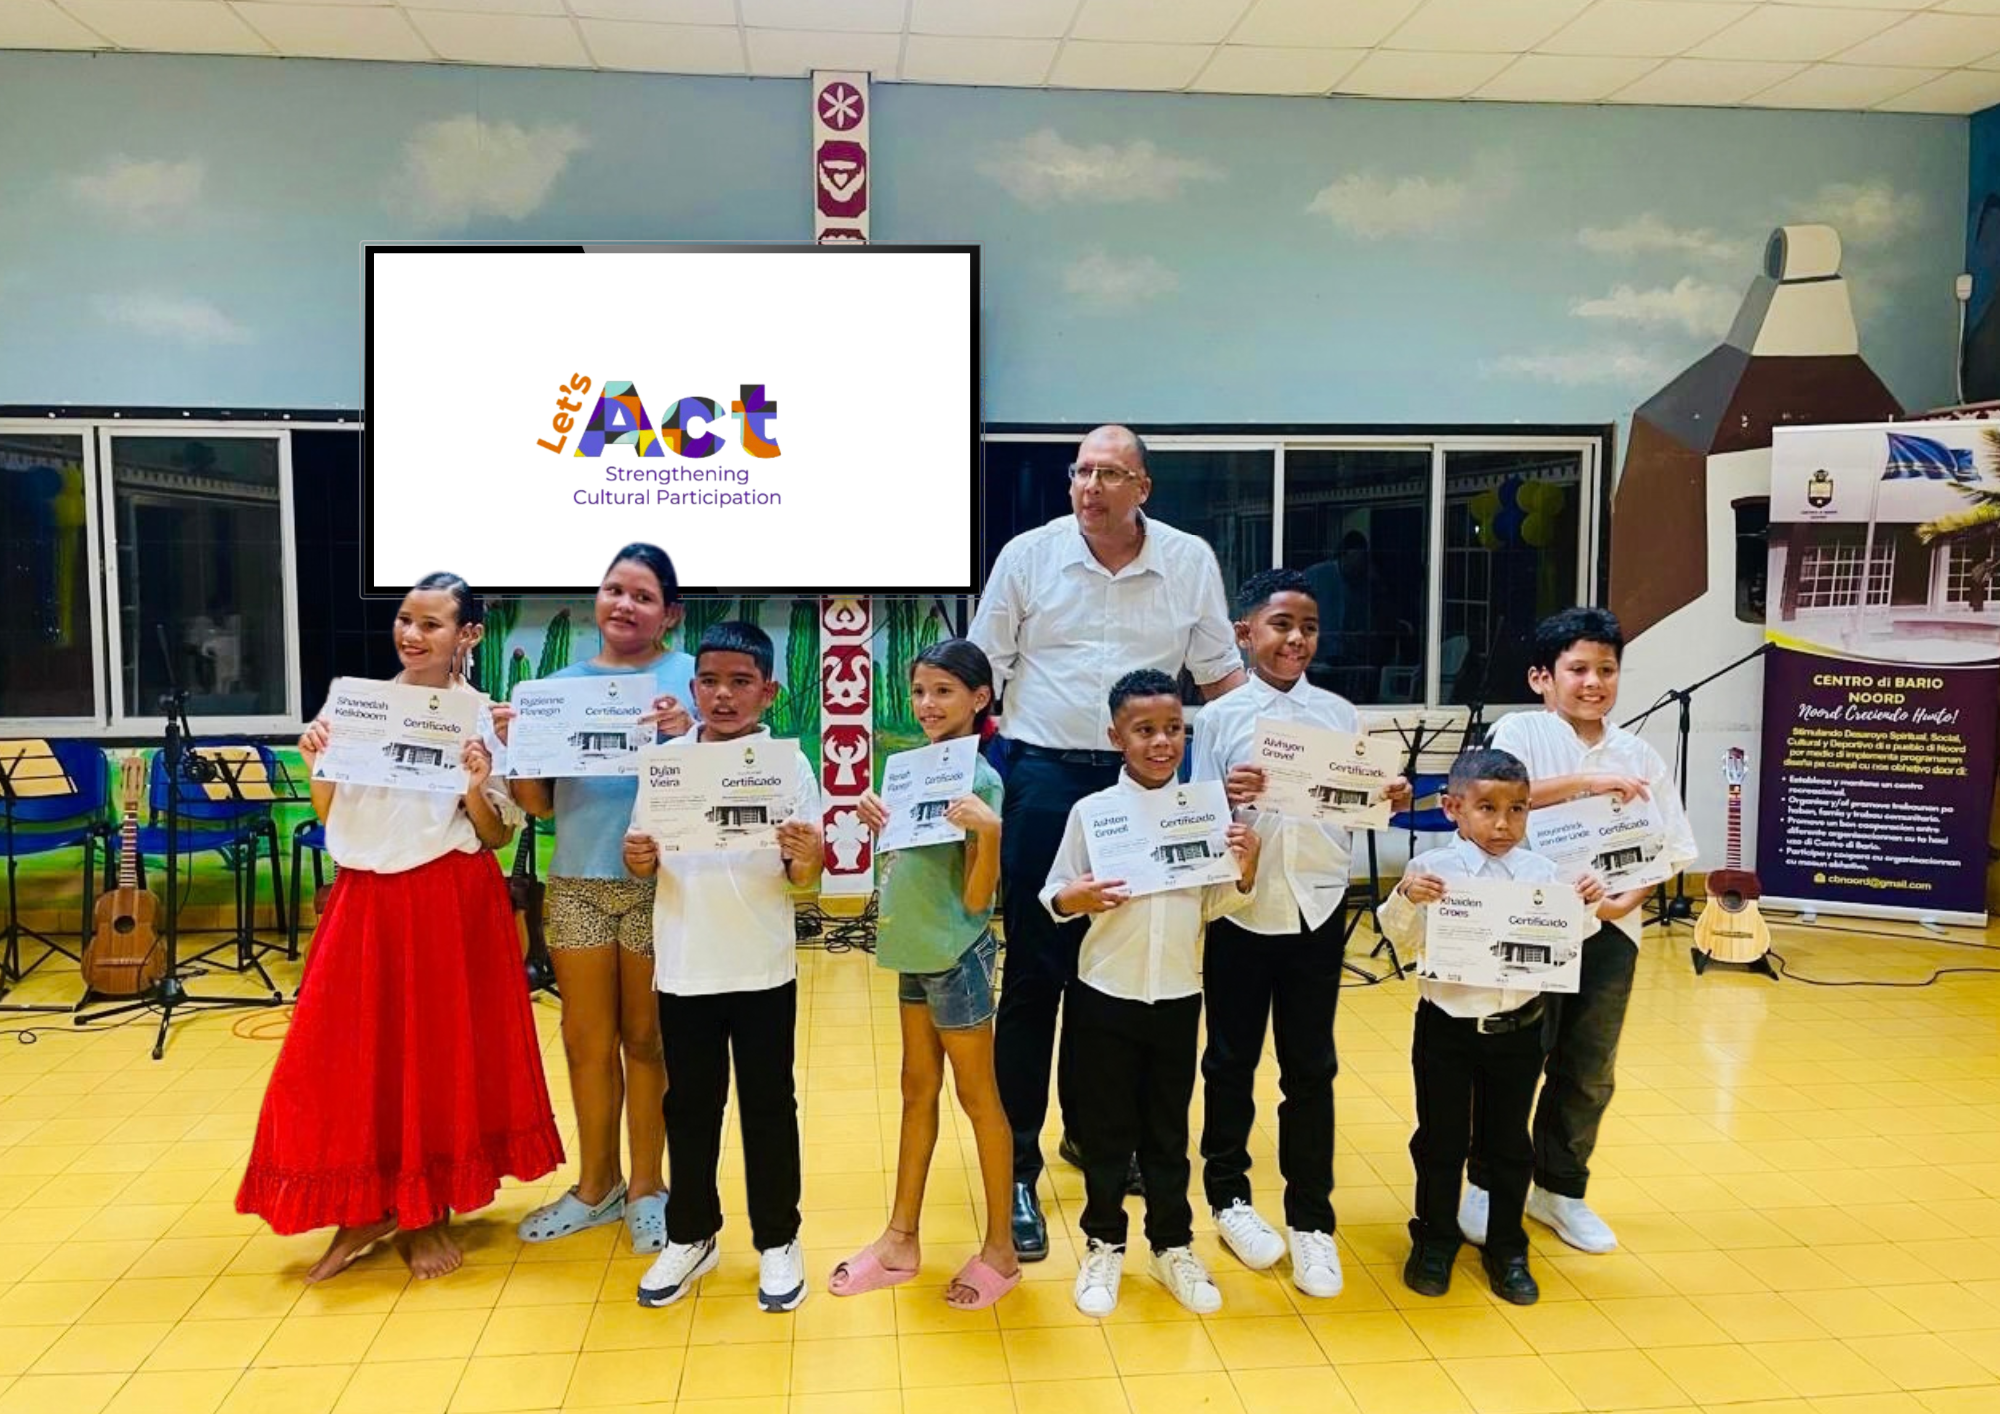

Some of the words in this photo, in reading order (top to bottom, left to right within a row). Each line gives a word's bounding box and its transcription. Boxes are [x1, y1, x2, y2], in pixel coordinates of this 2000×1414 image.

[536, 372, 592, 454] Let's
[573, 380, 782, 459] Act
[605, 466, 749, 485] Strengthening
[573, 489, 650, 505] Cultural
[657, 489, 782, 508] Participation
[1813, 675, 1873, 687] CENTRO
[1877, 676, 1891, 687] di
[1895, 677, 1944, 689] BARIO
[1848, 692, 1905, 704] NOORD
[585, 706, 642, 717] Certificado
[1798, 703, 1842, 720] Noord
[1845, 704, 1908, 722] Creciendo
[403, 717, 461, 734] Certificado
[1937, 744, 1967, 753] Noord
[649, 765, 681, 778] Dylan
[649, 778, 681, 788] Vieira
[721, 776, 782, 788] Certificado
[924, 772, 964, 786] Certificado
[1093, 815, 1128, 828] Ashton
[1160, 813, 1216, 829] Certificado
[1598, 819, 1649, 837] Certificado
[1828, 874, 1932, 891] cbnoord@gmail.com
[1508, 915, 1568, 929] Certificado
